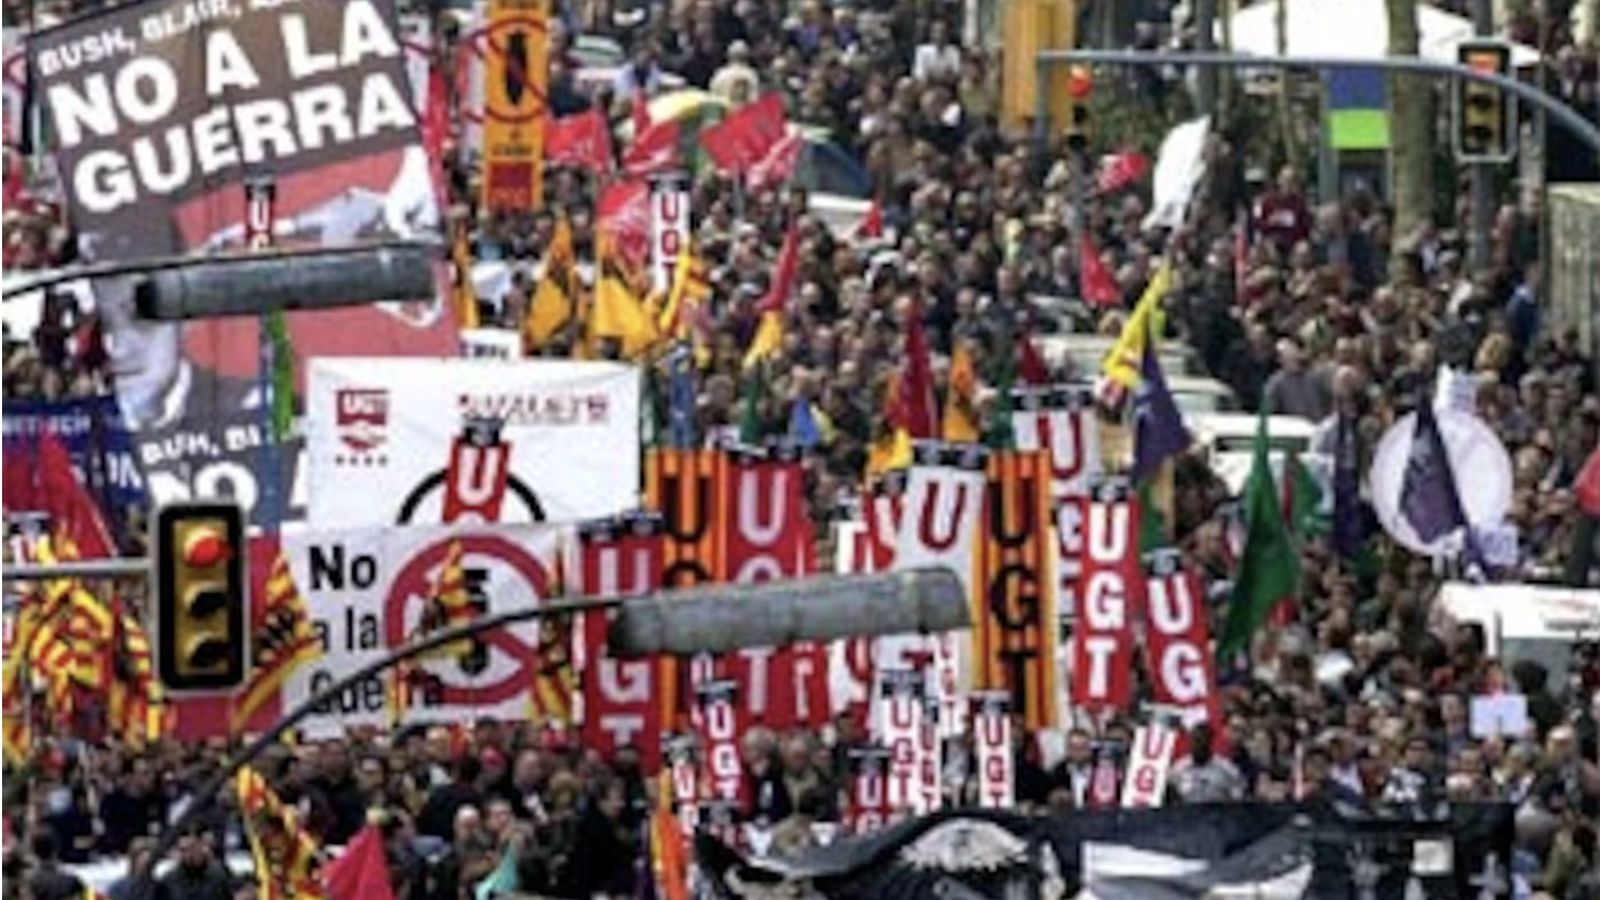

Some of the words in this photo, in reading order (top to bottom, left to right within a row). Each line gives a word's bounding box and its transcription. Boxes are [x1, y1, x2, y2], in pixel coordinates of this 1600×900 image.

[38, 27, 137, 77] BUSH,
[47, 57, 178, 147] NO
[207, 30, 259, 94] A
[280, 0, 400, 80] LA
[73, 73, 415, 213] GUERRA
[309, 545, 376, 591] No
[1084, 502, 1130, 698] UGT
[345, 606, 377, 651] la
